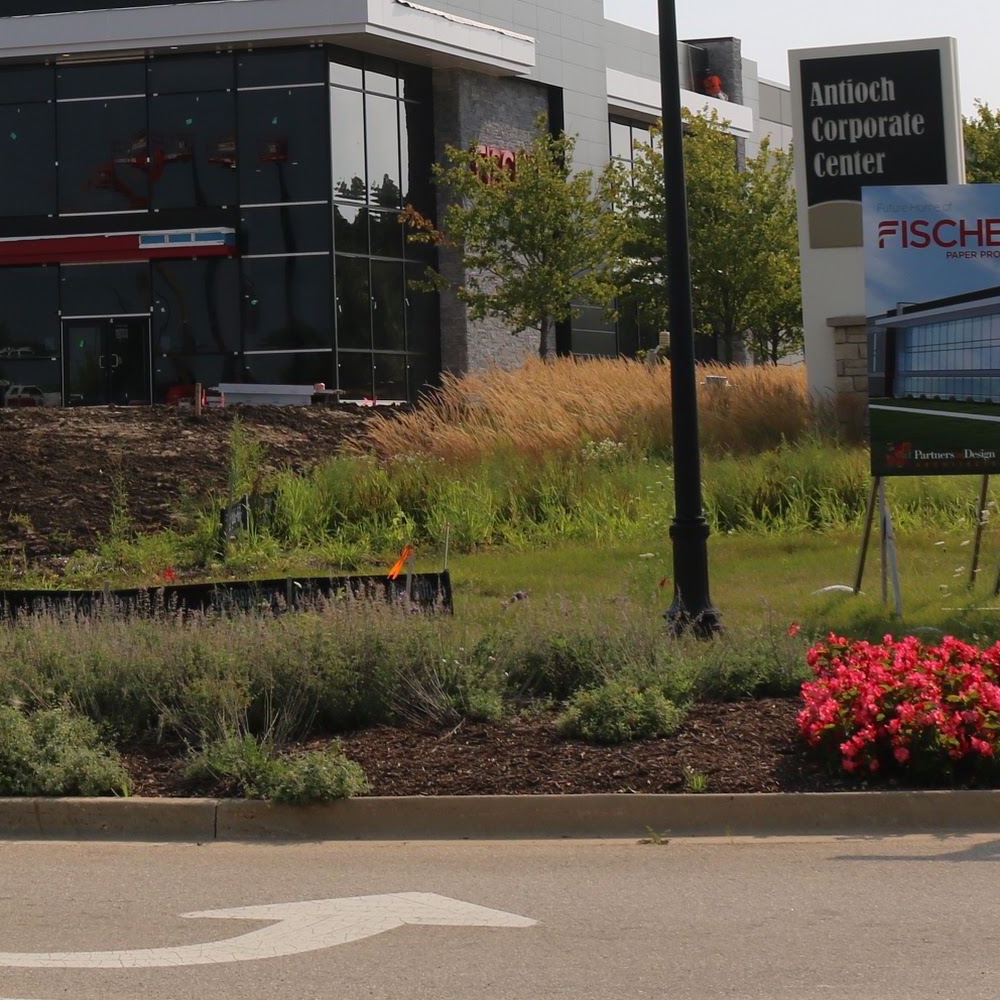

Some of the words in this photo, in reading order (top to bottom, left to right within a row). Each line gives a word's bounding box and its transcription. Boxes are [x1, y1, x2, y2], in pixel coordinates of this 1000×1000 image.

[810, 76, 896, 107] Antioch
[811, 111, 925, 143] Corporate
[813, 150, 886, 178] Center
[946, 250, 977, 260] PAPER
[914, 449, 956, 461] Partners
[964, 448, 996, 462] Design
